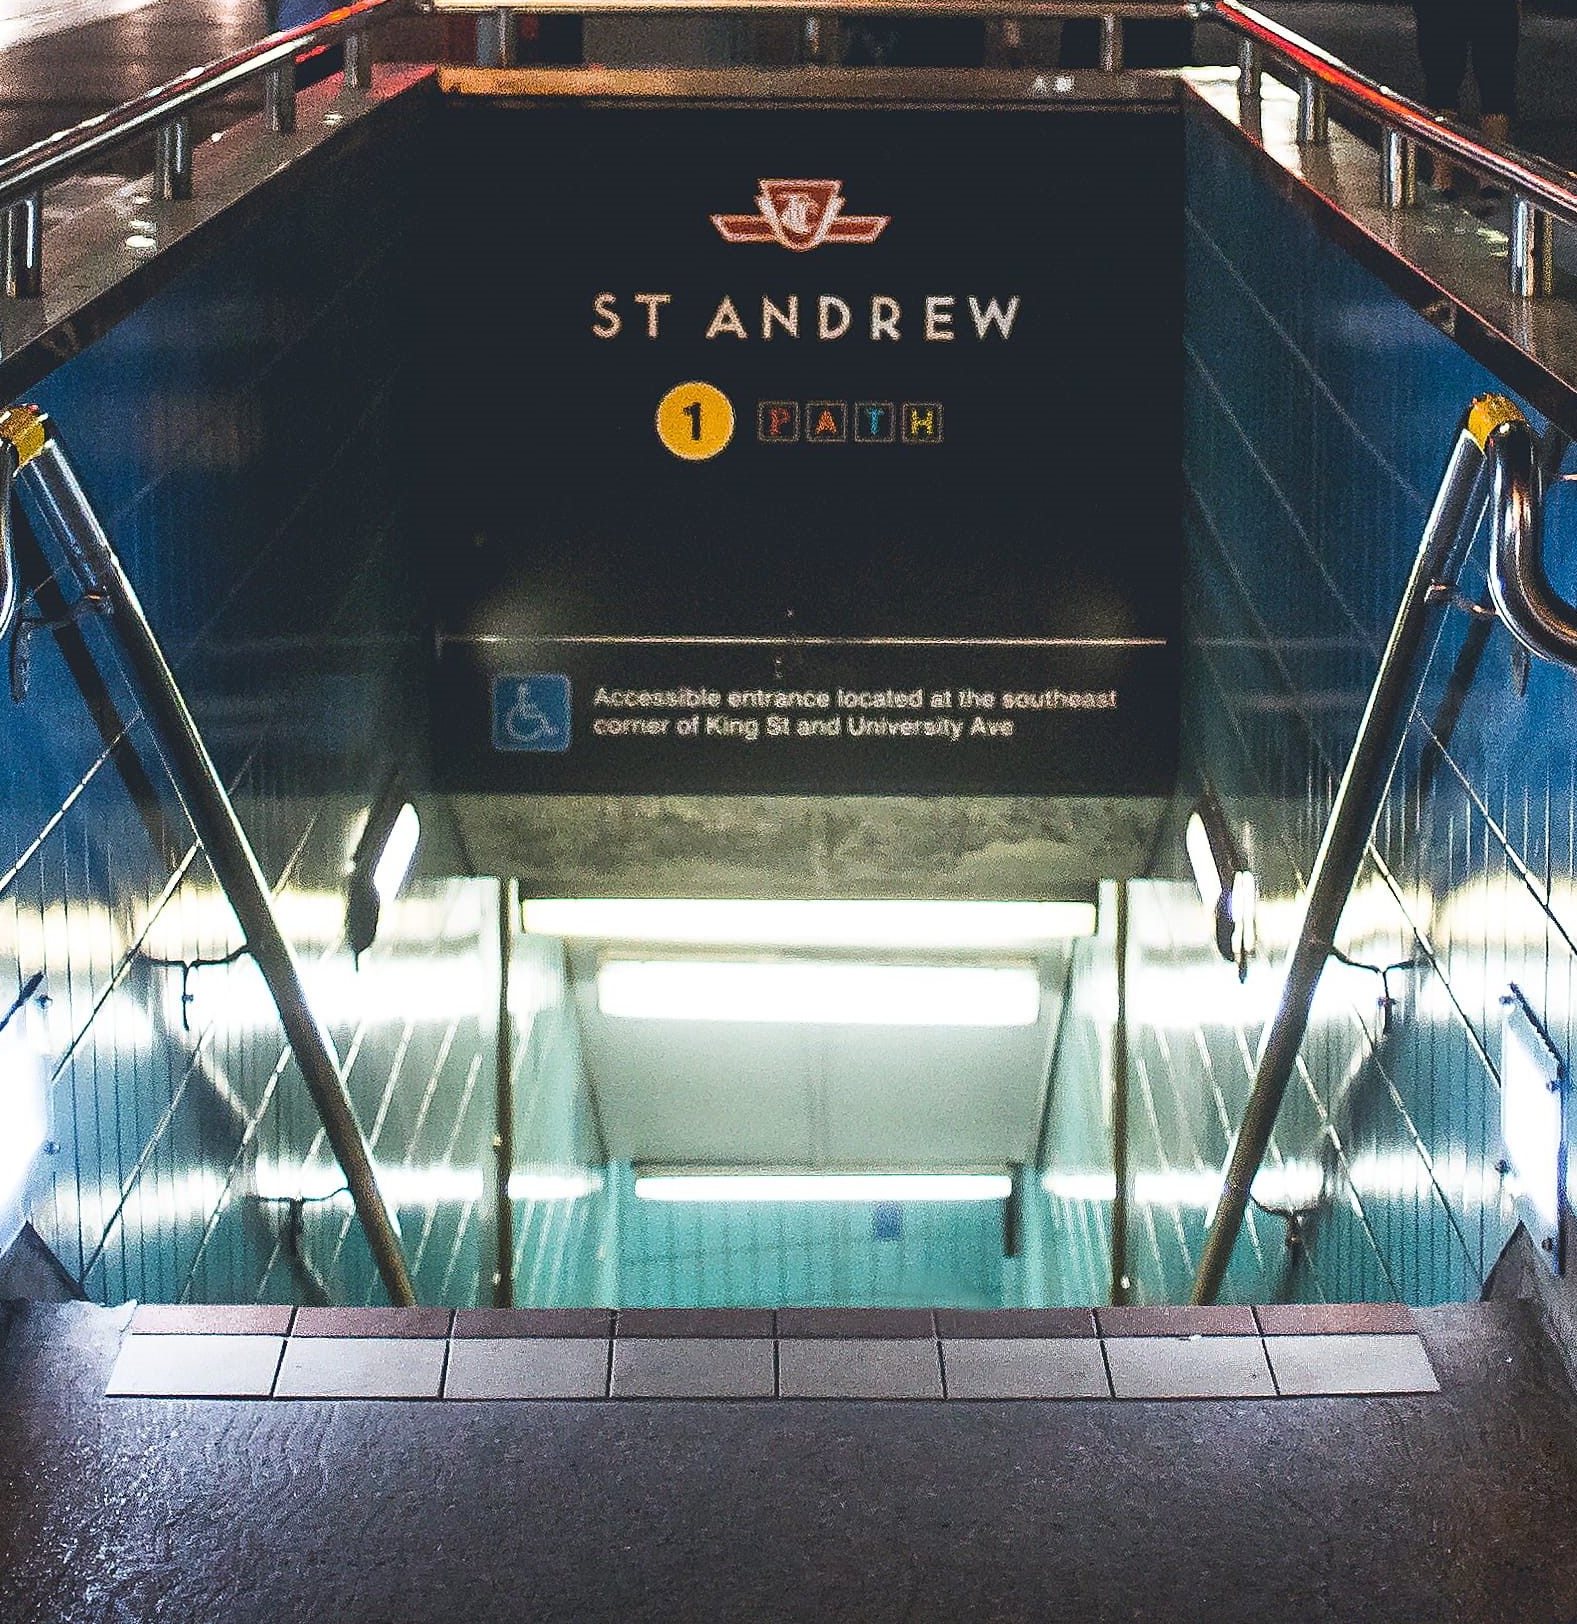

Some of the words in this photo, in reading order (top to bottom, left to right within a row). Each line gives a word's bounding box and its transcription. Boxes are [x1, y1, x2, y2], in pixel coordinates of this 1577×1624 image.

[592, 292, 672, 339] ST
[705, 294, 1021, 342] ANDREW
[765, 405, 938, 439] PATH
[593, 687, 723, 709] Accessible
[726, 689, 831, 709] entrance
[836, 688, 924, 709] located
[929, 689, 953, 709] at
[957, 688, 996, 709] the
[1000, 688, 1118, 710] southeast
[592, 718, 670, 737] corner
[675, 714, 701, 737] of
[704, 714, 761, 742] King
[765, 713, 791, 737] St
[795, 715, 842, 737] and
[846, 716, 964, 741] University
[968, 715, 1015, 737] Ave
